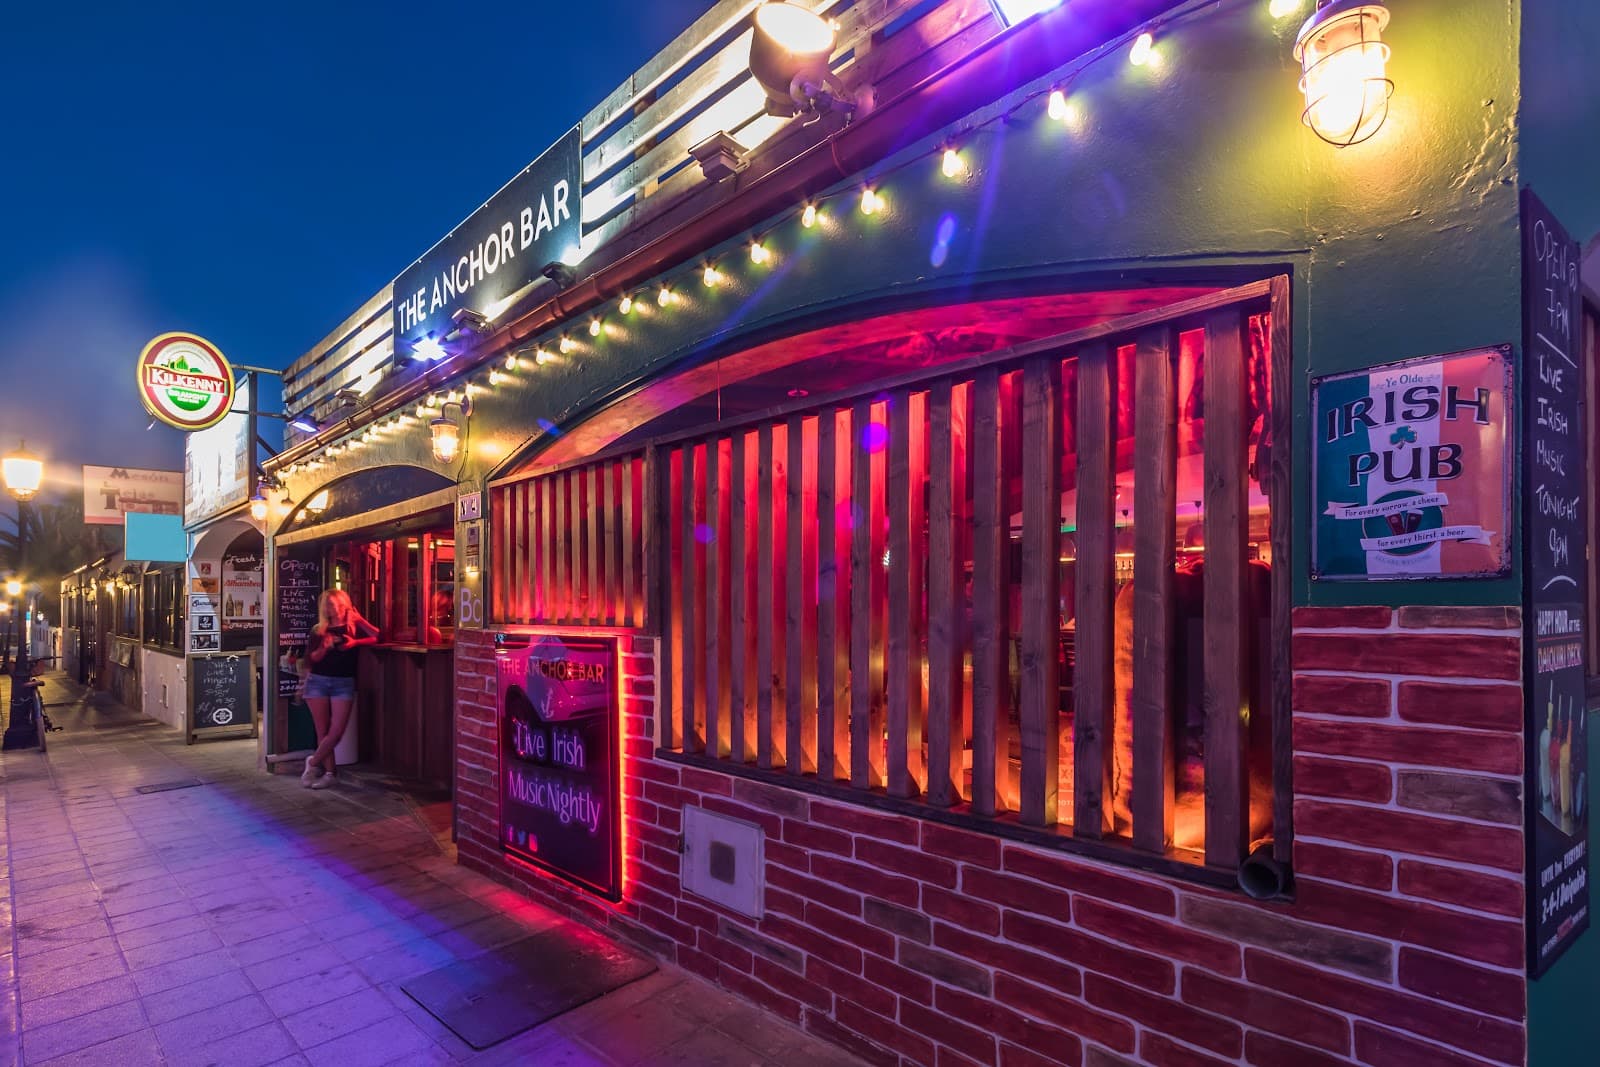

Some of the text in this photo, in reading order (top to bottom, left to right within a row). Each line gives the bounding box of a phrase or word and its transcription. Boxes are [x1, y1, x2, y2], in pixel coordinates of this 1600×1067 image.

[398, 179, 571, 334] THE ANCHOR BAR
[1534, 219, 1567, 281] OPEN
[151, 368, 223, 393] KILKENNY
[1386, 374, 1423, 388] Ye Olde
[1540, 354, 1563, 393] LIVE
[1327, 386, 1490, 443] IRISH
[1537, 397, 1568, 435] IRISH
[1348, 443, 1464, 487] PUB
[1537, 439, 1565, 476] MUSIC
[1345, 509, 1357, 517] For
[1358, 507, 1380, 516] every
[1417, 497, 1439, 505] cheer
[1536, 484, 1580, 521] TONIGHT
[1377, 539, 1389, 547] for
[1390, 537, 1412, 546] every
[1447, 529, 1465, 537] beer
[225, 554, 256, 566] Fresh
[1537, 610, 1554, 636] HAPPY
[1555, 609, 1569, 634] HOUR
[503, 659, 605, 684] THE ANCHOR BAR
[1537, 643, 1582, 674] DAIQUIRI DECK
[515, 723, 584, 767] Live Irish
[509, 771, 601, 833] Music Nightly
